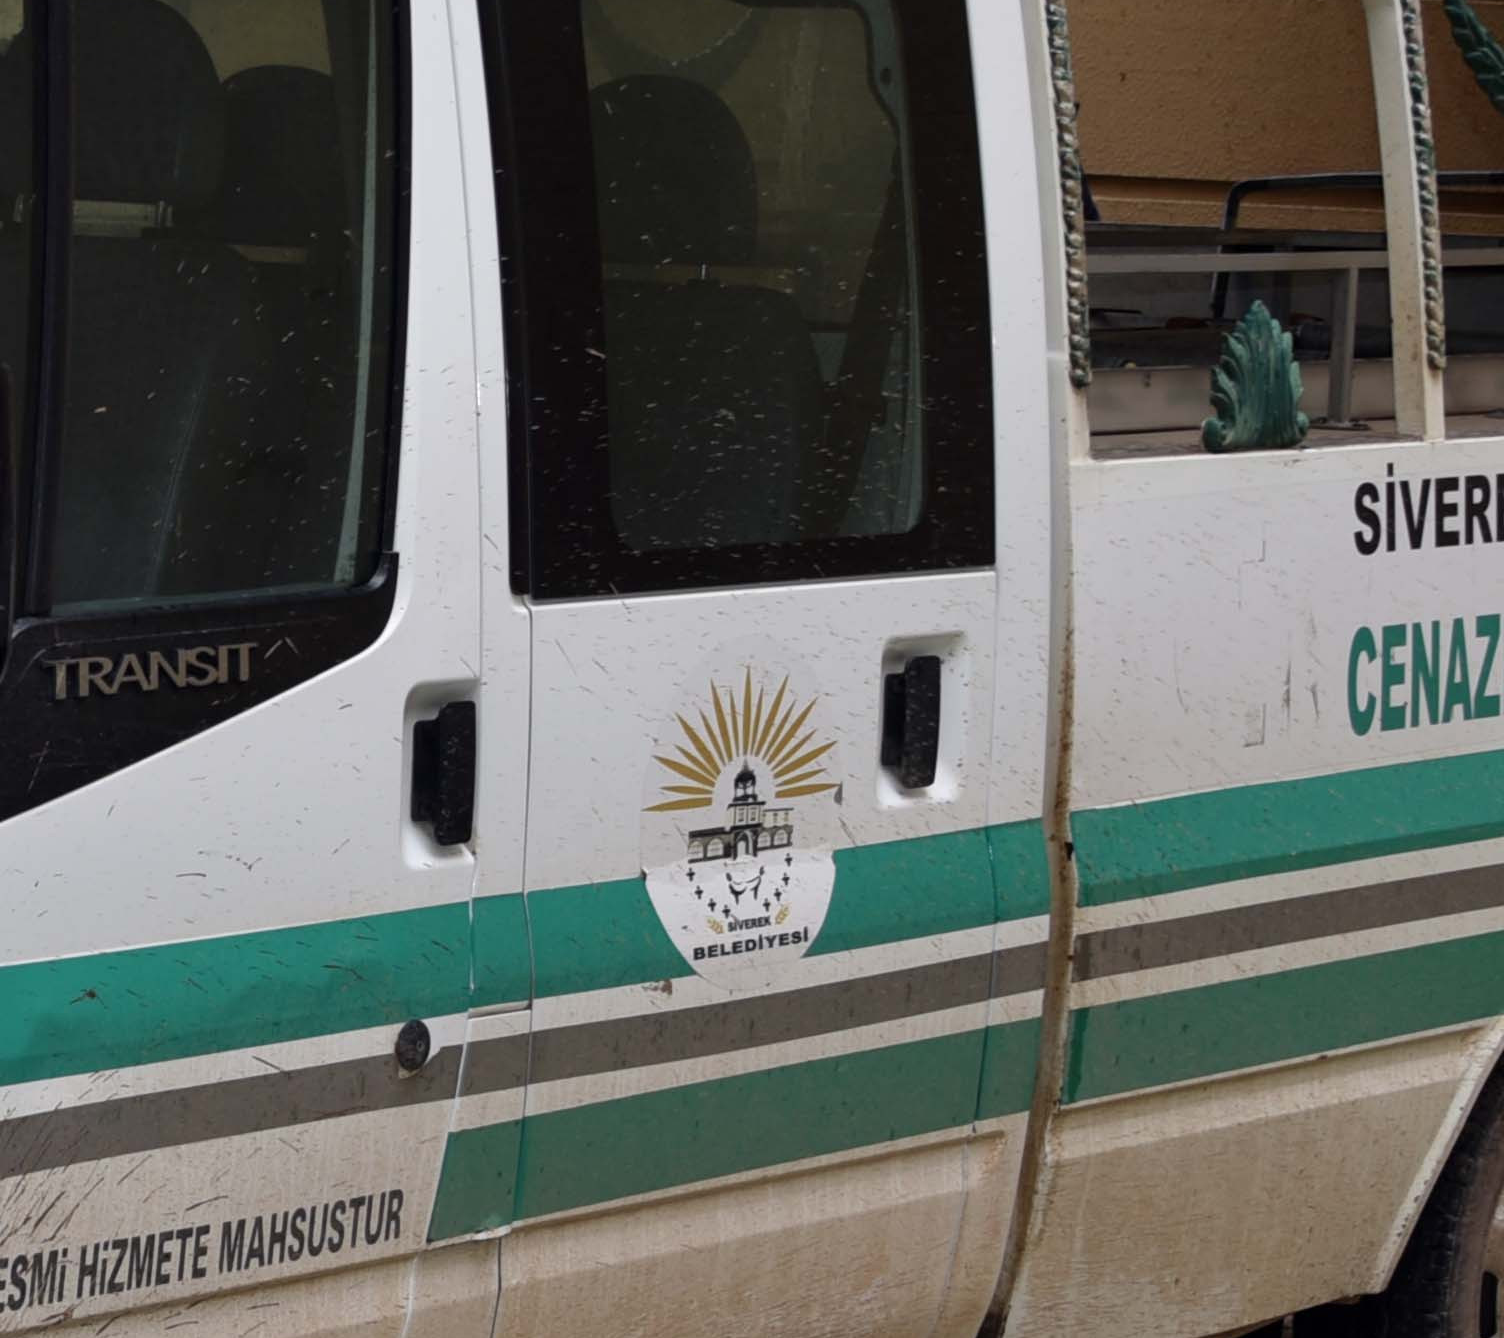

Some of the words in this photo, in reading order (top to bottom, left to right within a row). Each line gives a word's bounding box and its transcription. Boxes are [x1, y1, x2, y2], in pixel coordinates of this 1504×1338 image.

[43, 642, 259, 700] TRANSIT
[693, 926, 809, 961] BELEDİYESİ
[727, 914, 772, 933] SİVEREK
[218, 1189, 404, 1274] MAHSUSTUR
